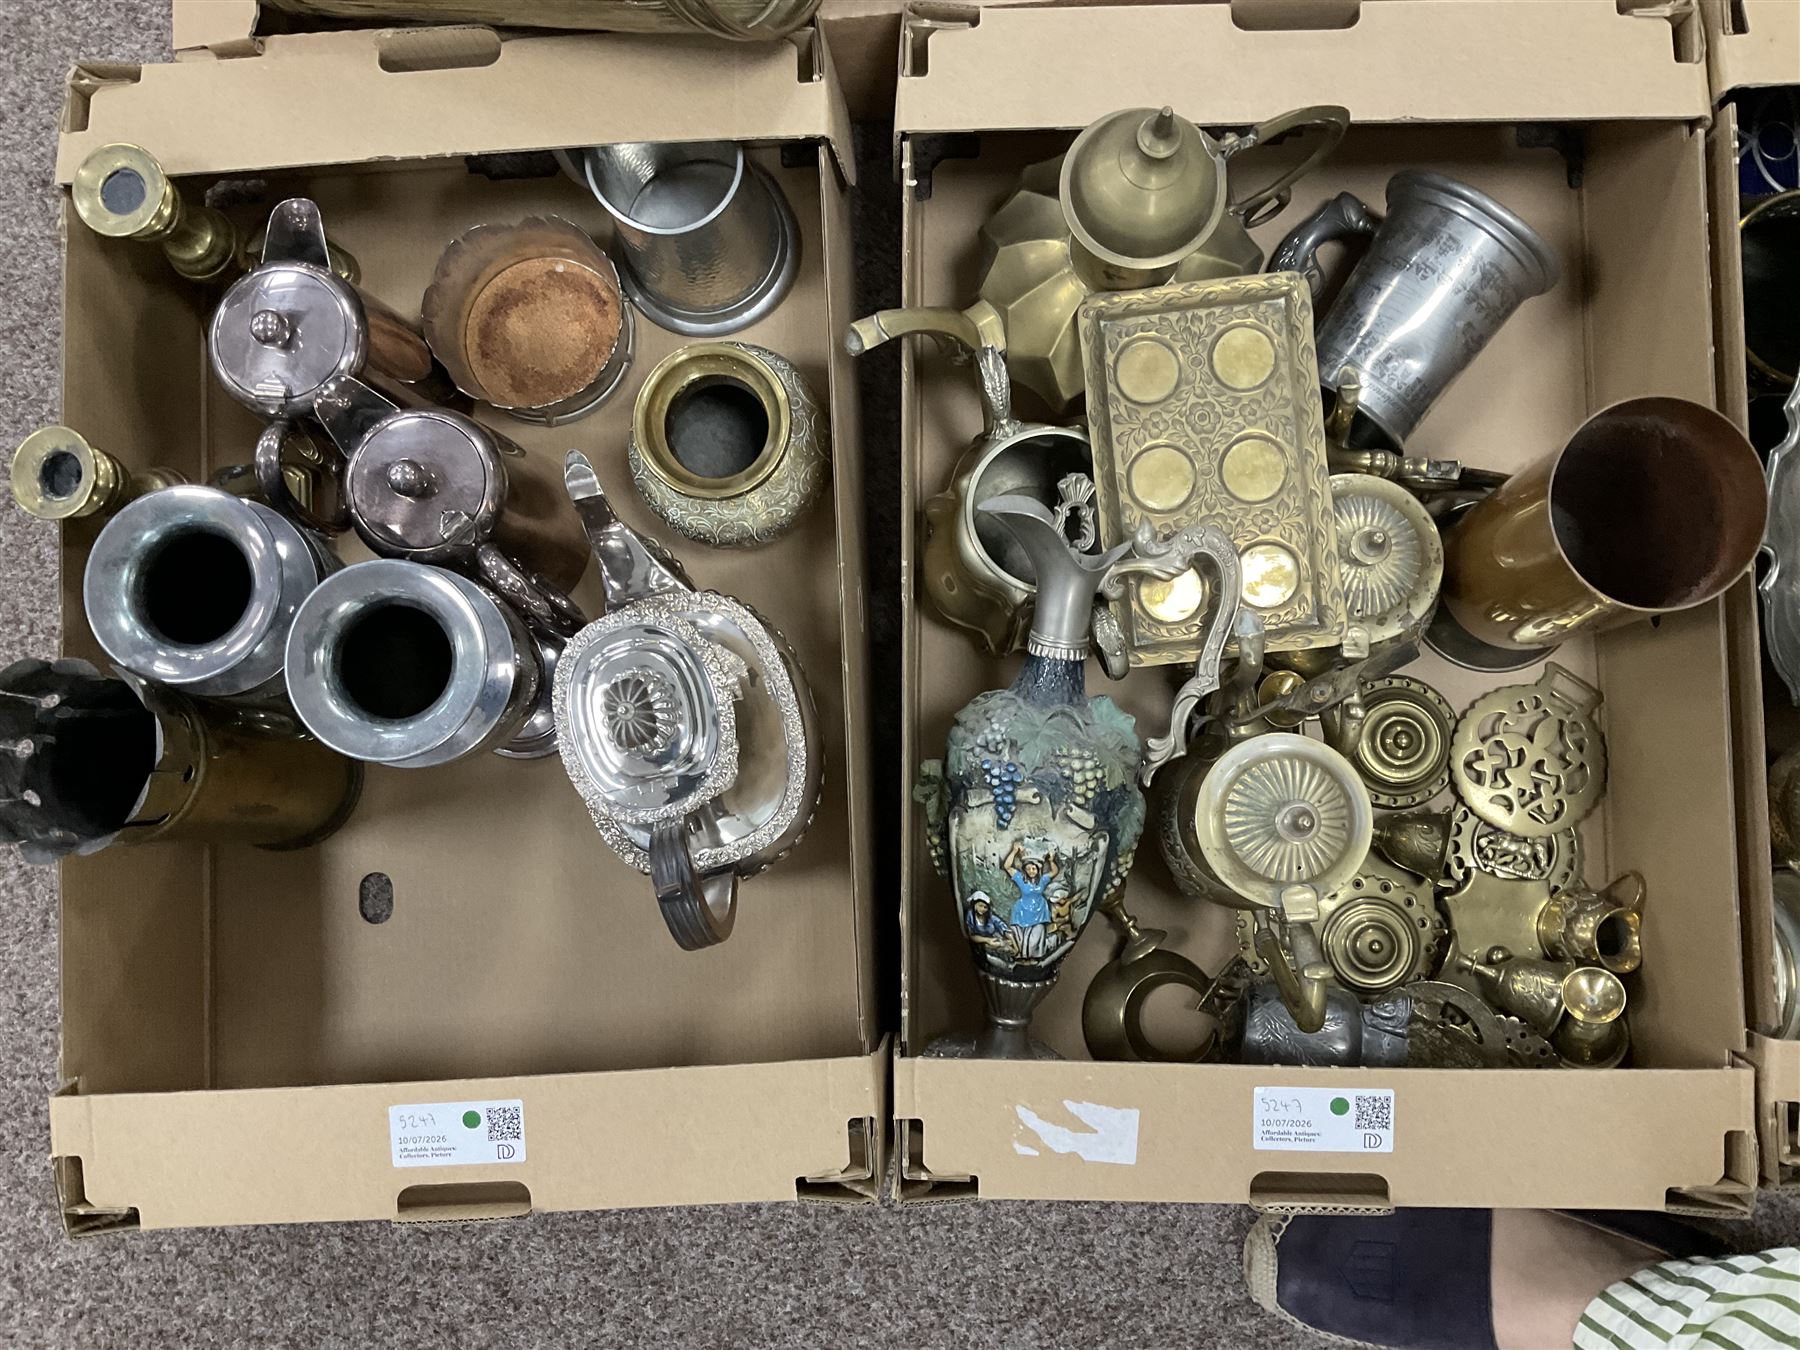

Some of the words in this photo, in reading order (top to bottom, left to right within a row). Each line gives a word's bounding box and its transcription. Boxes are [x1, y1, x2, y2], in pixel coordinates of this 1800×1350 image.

[1261, 1097, 1302, 1113] 5247
[399, 1113, 436, 1129] 5247
[1261, 1119, 1312, 1128] 10/07/2026
[1261, 1129, 1292, 1137] Affordable
[398, 1135, 447, 1145] 10/07/2026
